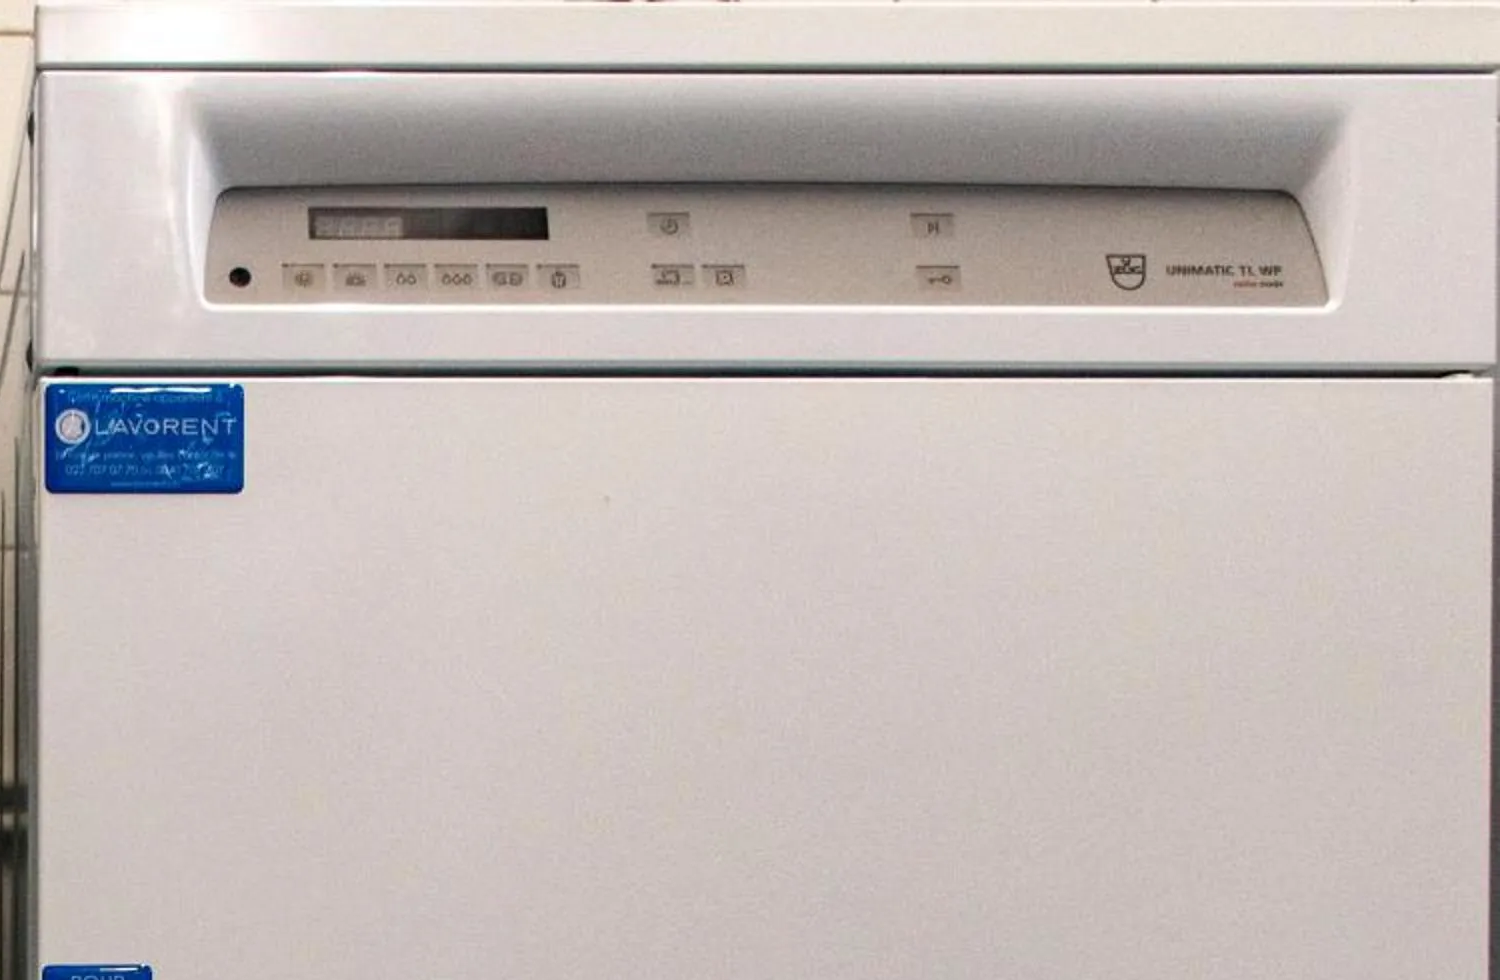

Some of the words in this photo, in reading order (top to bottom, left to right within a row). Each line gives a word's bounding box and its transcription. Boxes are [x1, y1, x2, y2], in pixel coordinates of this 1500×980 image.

[1165, 264, 1235, 277] UNIMATIC
[1238, 264, 1256, 277] TL
[94, 417, 238, 436] LAVORENT
